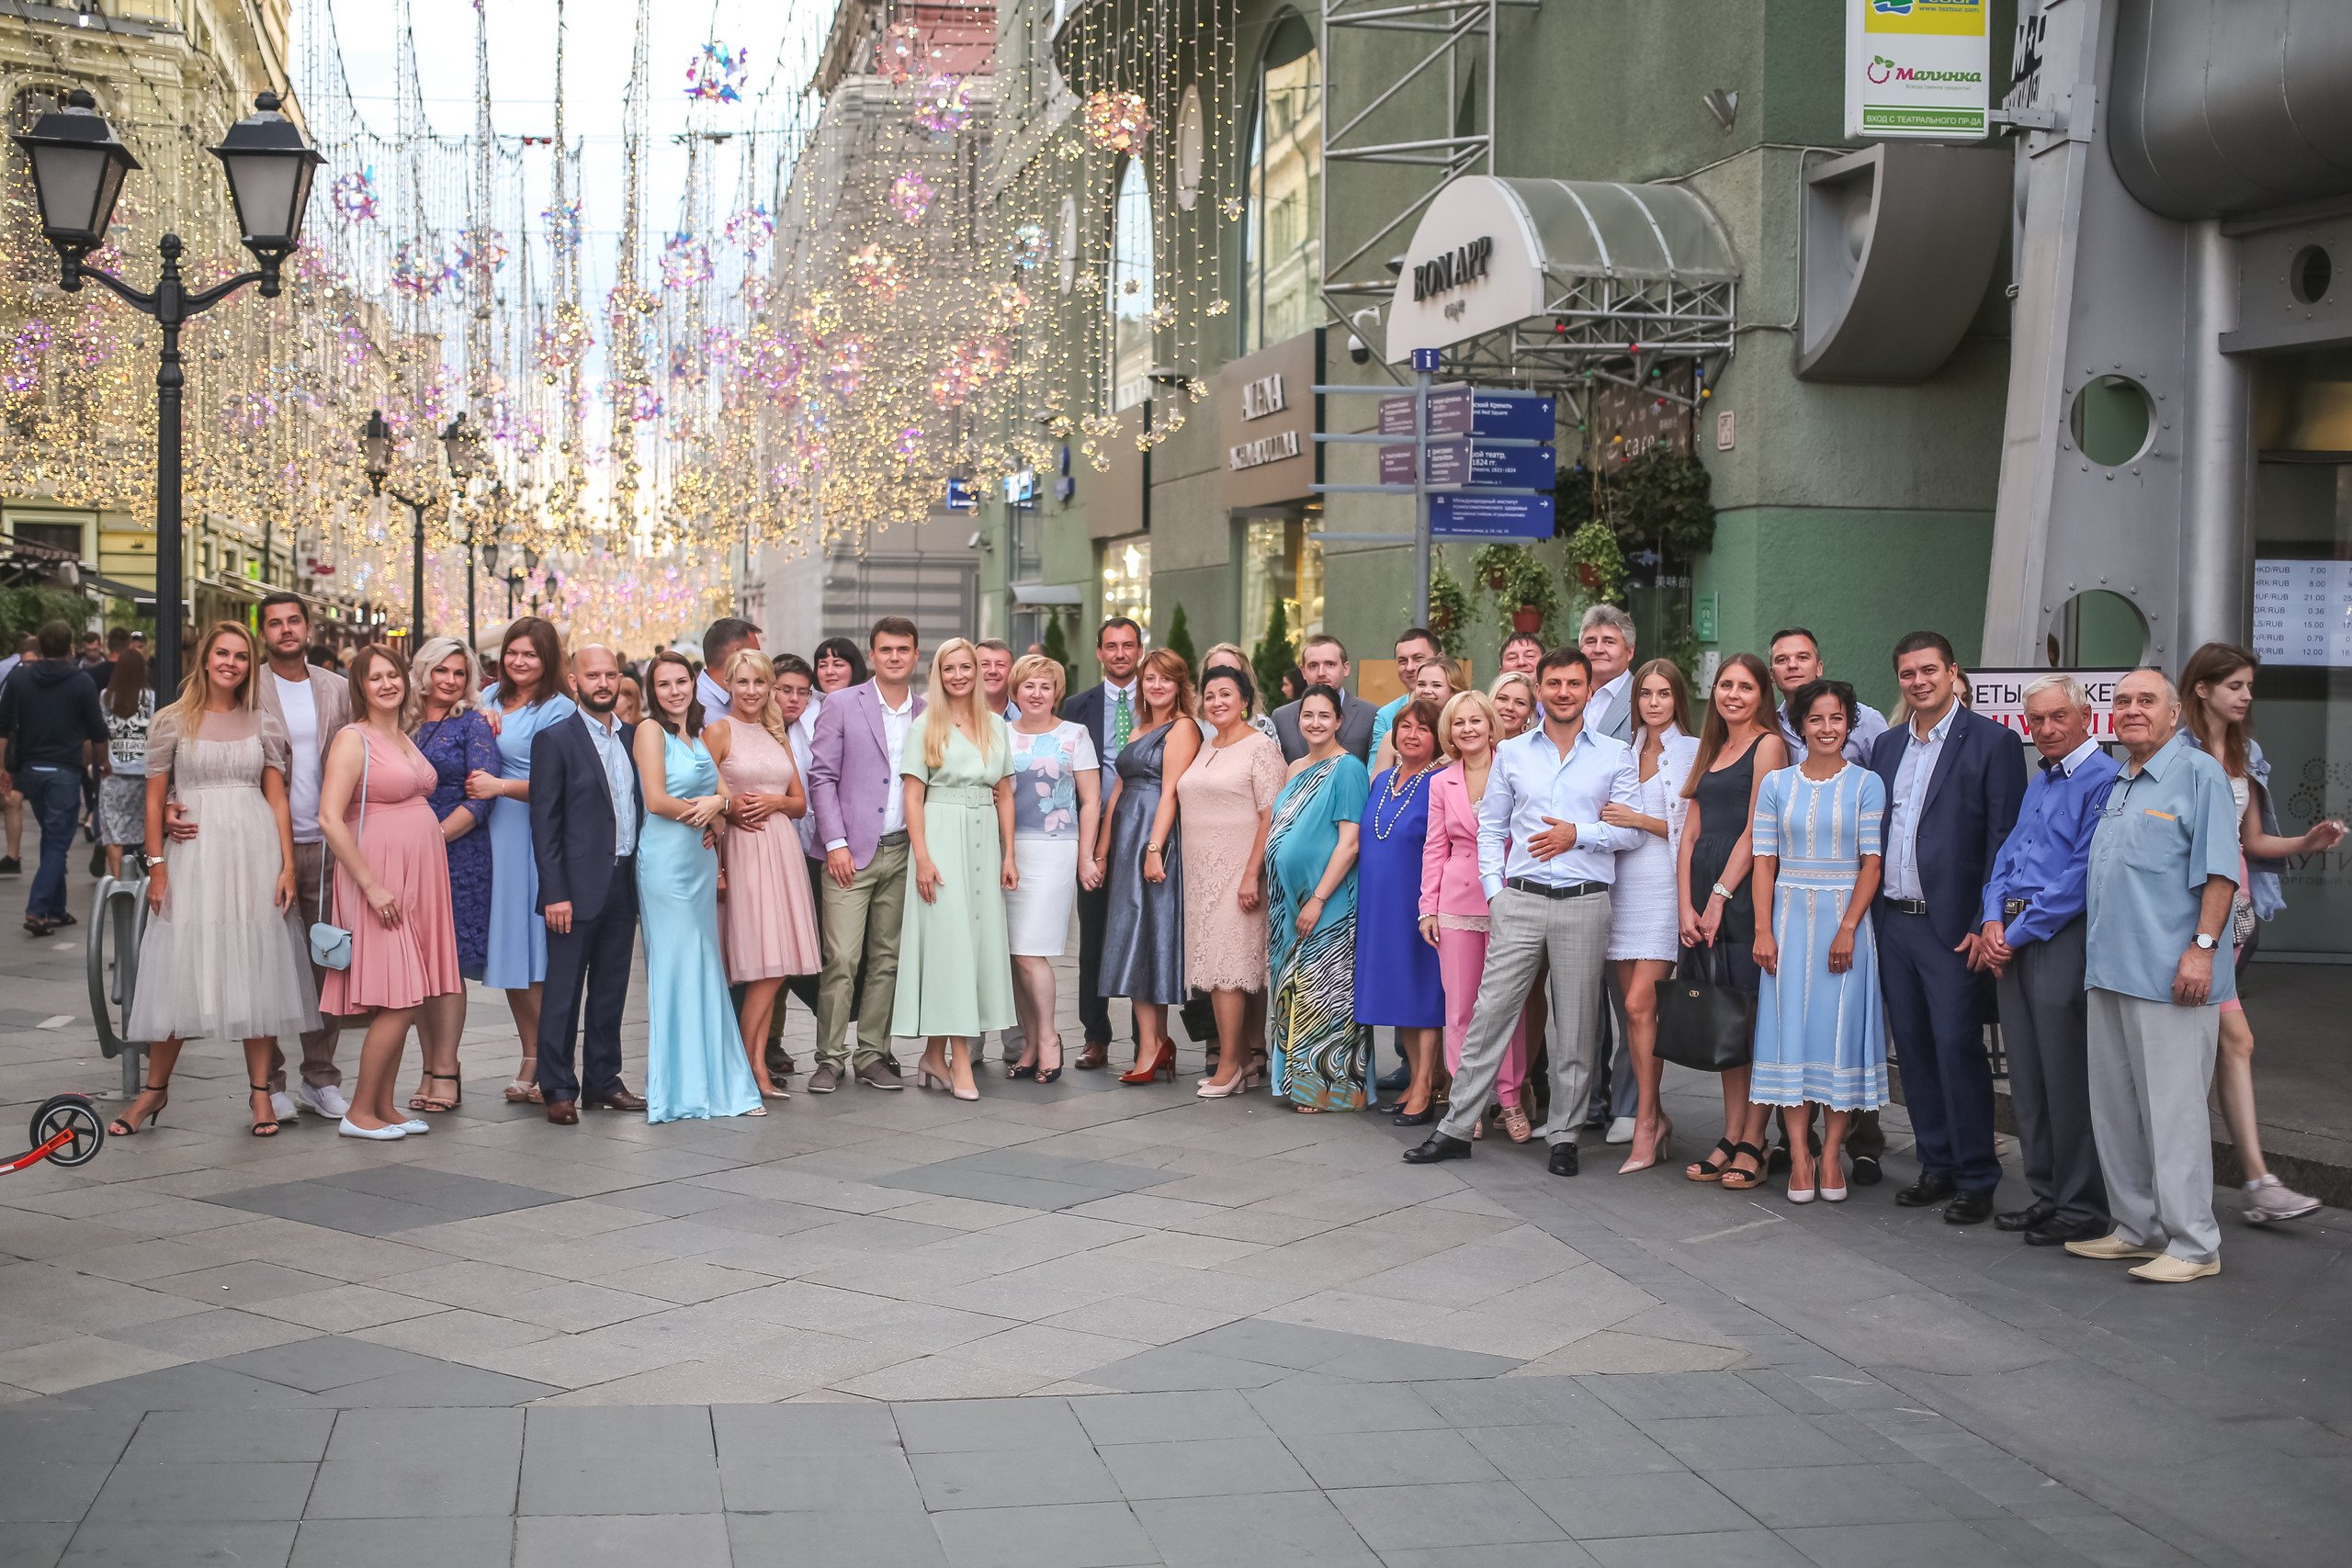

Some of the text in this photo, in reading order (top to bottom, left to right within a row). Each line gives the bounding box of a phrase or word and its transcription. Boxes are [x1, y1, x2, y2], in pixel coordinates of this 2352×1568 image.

[1895, 67, 1982, 83] Малинка
[1866, 114, 1983, 126] ВХОД С ТЕАТРАЛЬНОГО ПР-ДА
[1413, 235, 1493, 301] BON APP
[1472, 458, 1488, 467] 1824
[1976, 685, 2021, 704] ЕТЫ
